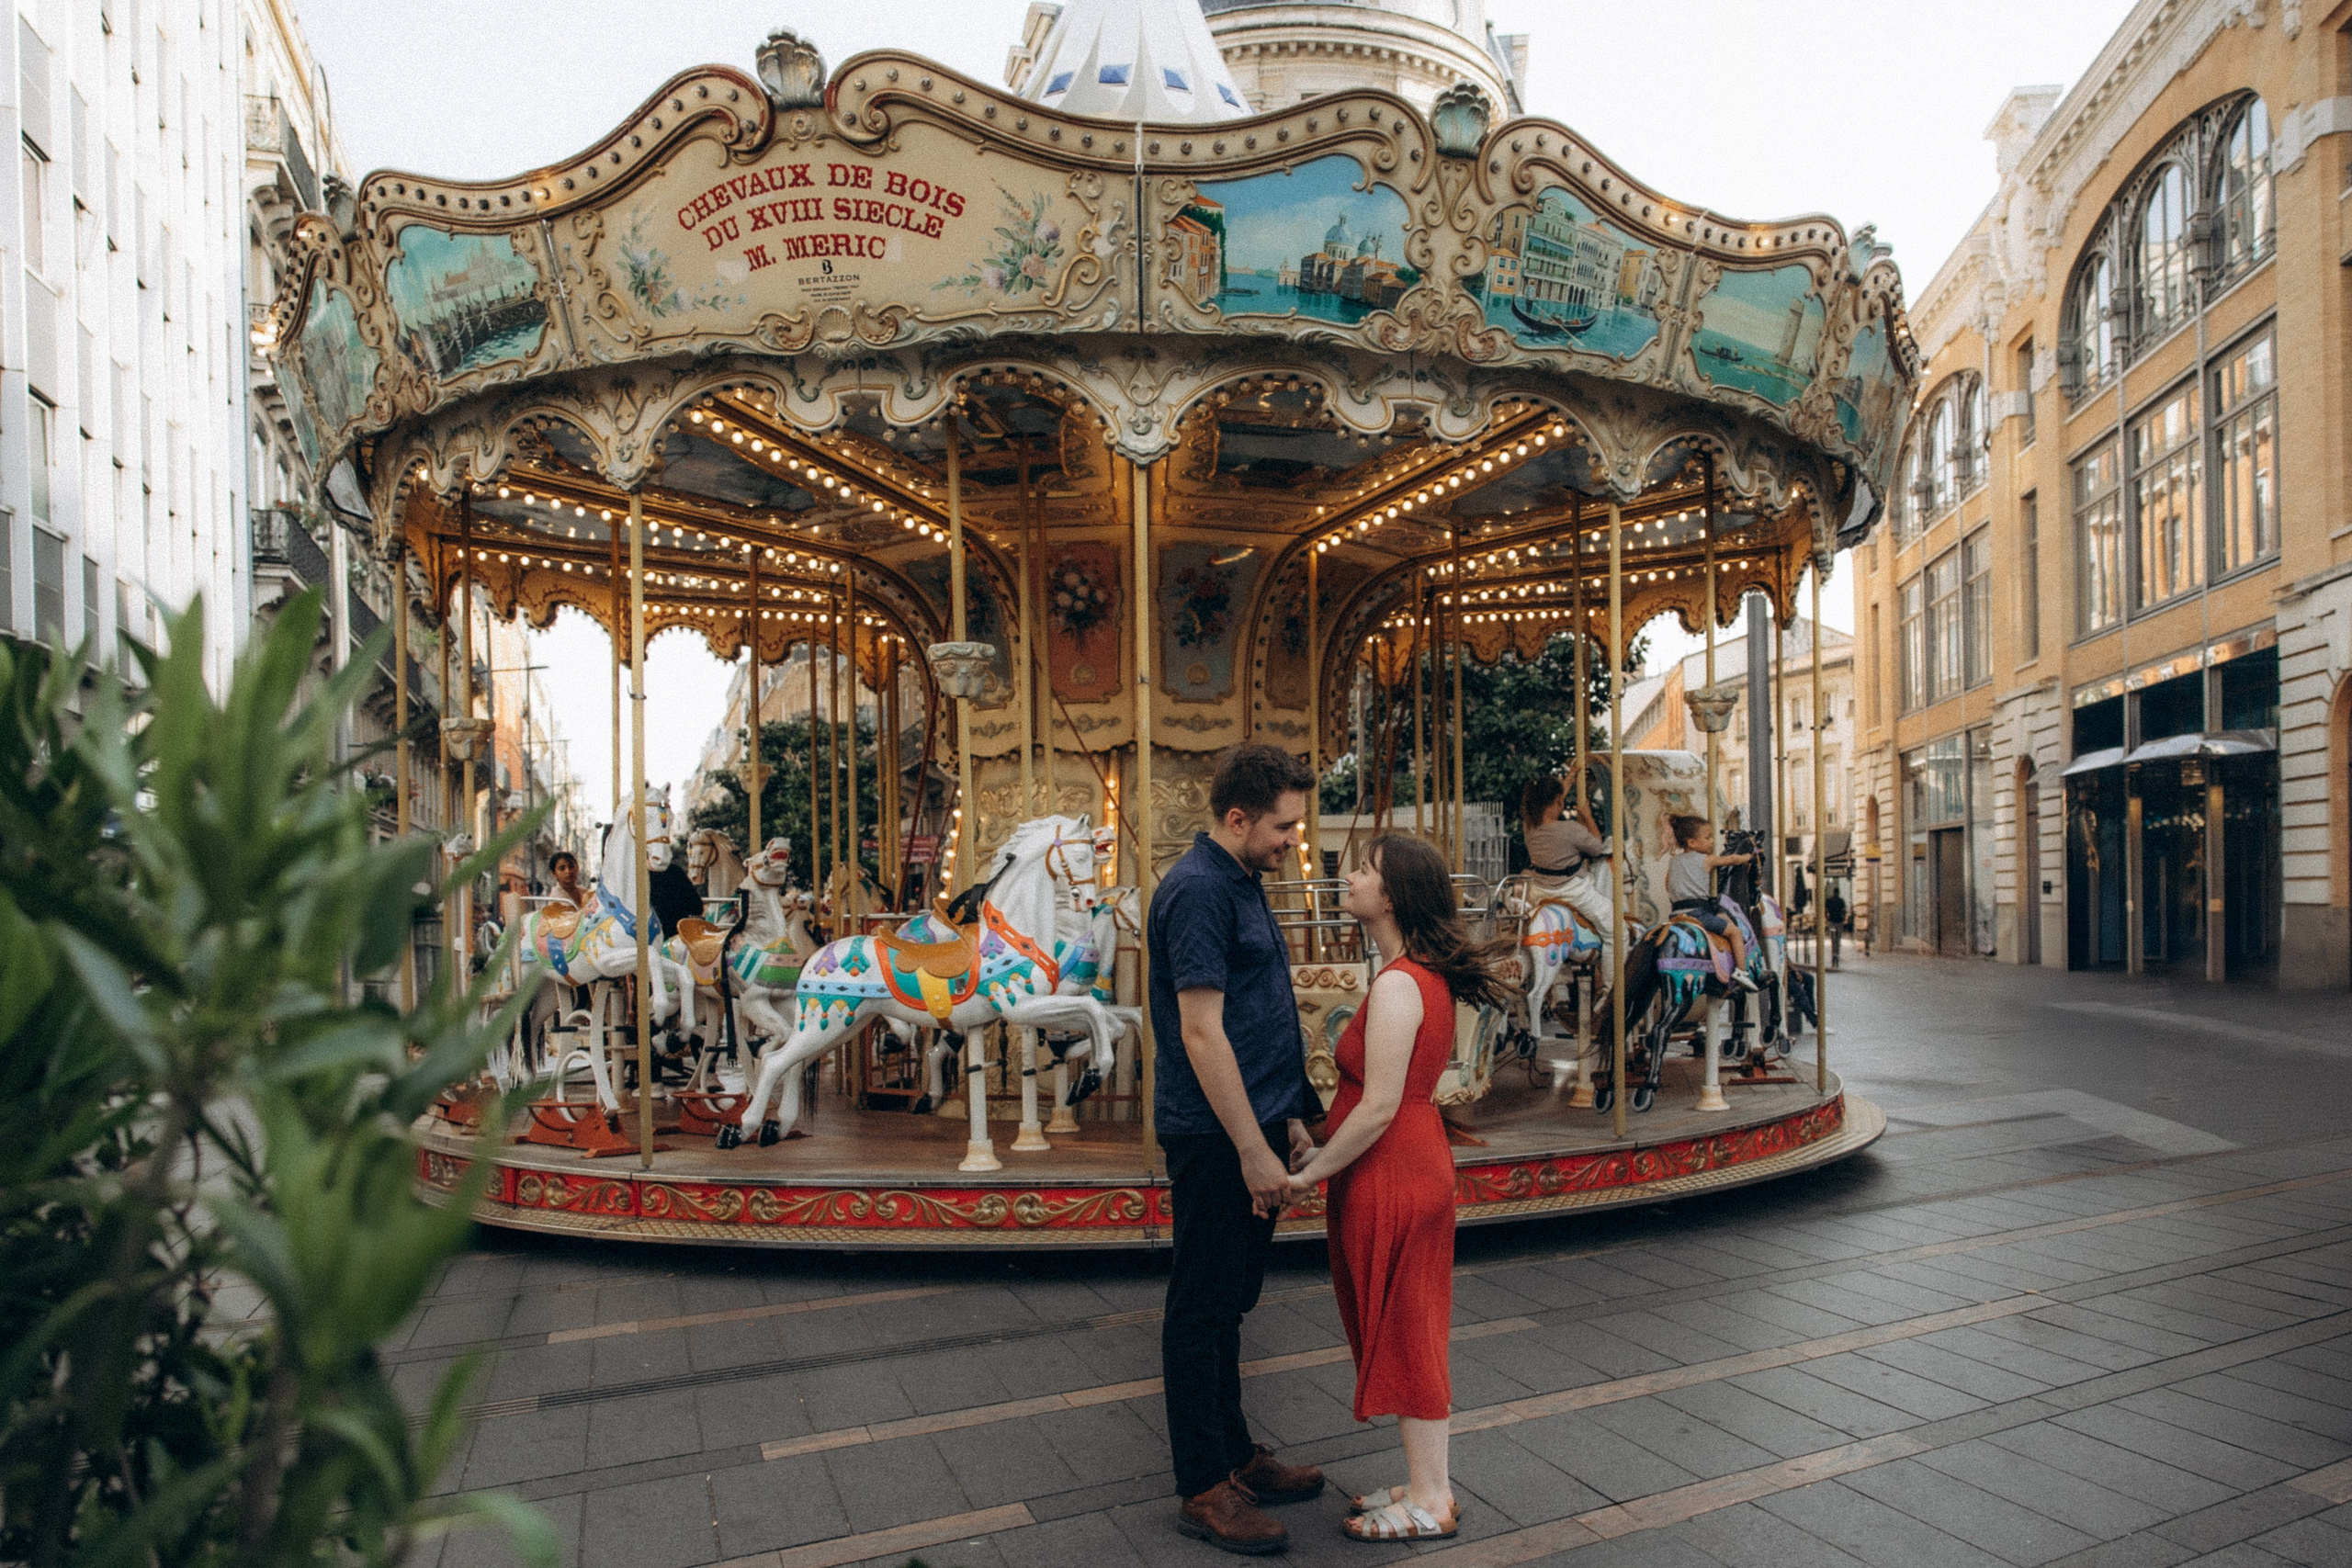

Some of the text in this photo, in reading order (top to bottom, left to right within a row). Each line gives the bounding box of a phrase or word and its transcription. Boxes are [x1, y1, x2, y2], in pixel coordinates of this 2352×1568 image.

[677, 164, 967, 231] CHEVAUX DE BOIS
[702, 197, 944, 252] DU XVIII SIECLE
[743, 233, 887, 272] M. MERIC
[797, 274, 860, 286] BERTAZZON
